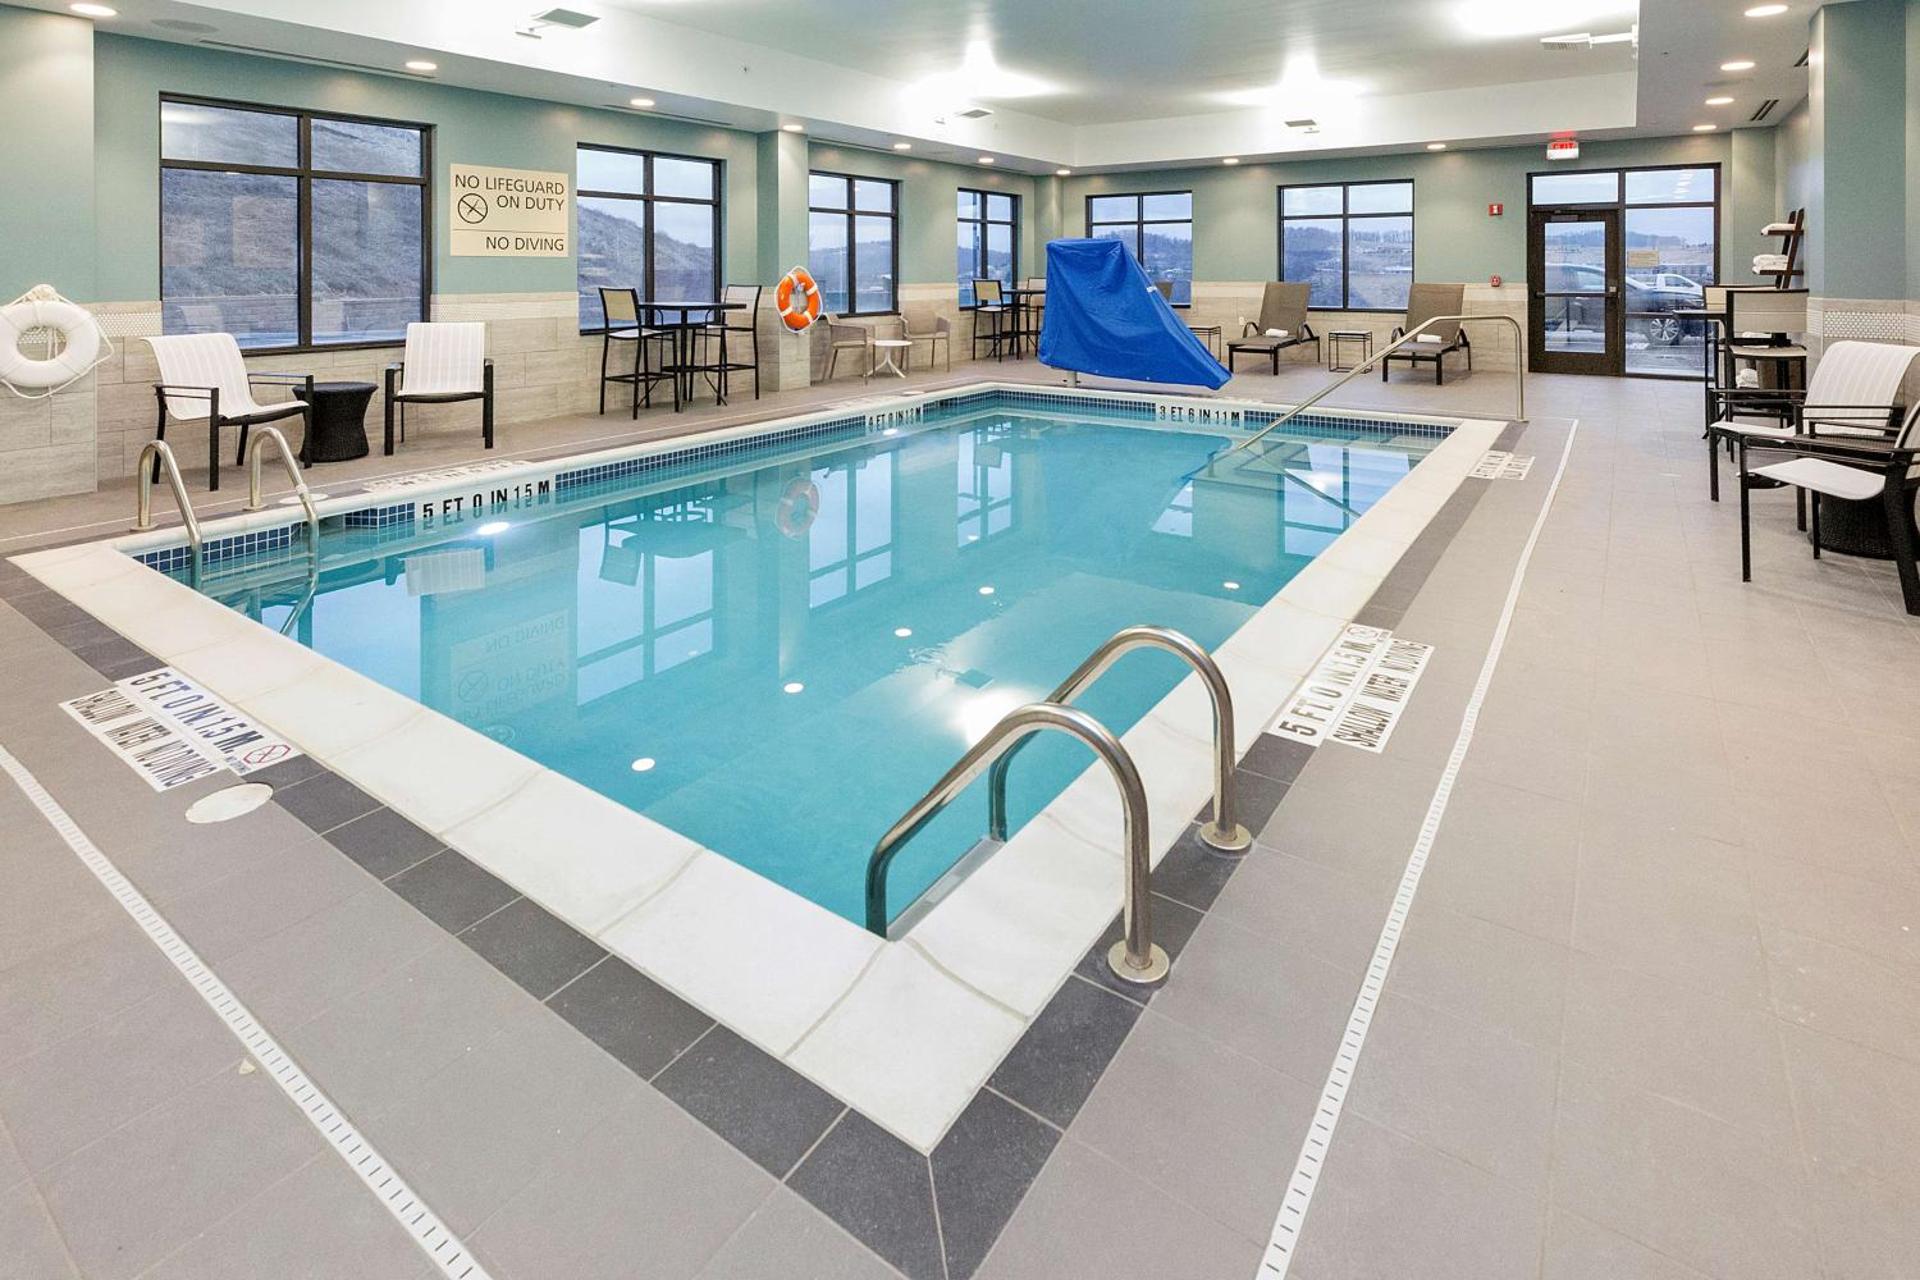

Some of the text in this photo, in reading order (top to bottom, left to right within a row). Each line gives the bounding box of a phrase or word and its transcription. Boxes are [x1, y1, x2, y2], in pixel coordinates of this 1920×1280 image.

[455, 174, 564, 195] NO LIFEGUARD
[496, 194, 564, 211] ON DUTY
[485, 236, 564, 251] NO DIVING
[1170, 406, 1184, 416] FT
[1199, 409, 1210, 418] IN
[1231, 412, 1240, 421] M
[423, 503, 433, 518] 5
[443, 497, 464, 514] FT
[491, 488, 507, 504] IN
[538, 480, 549, 494] M
[130, 672, 171, 687] 5
[1278, 720, 1317, 737] 5
